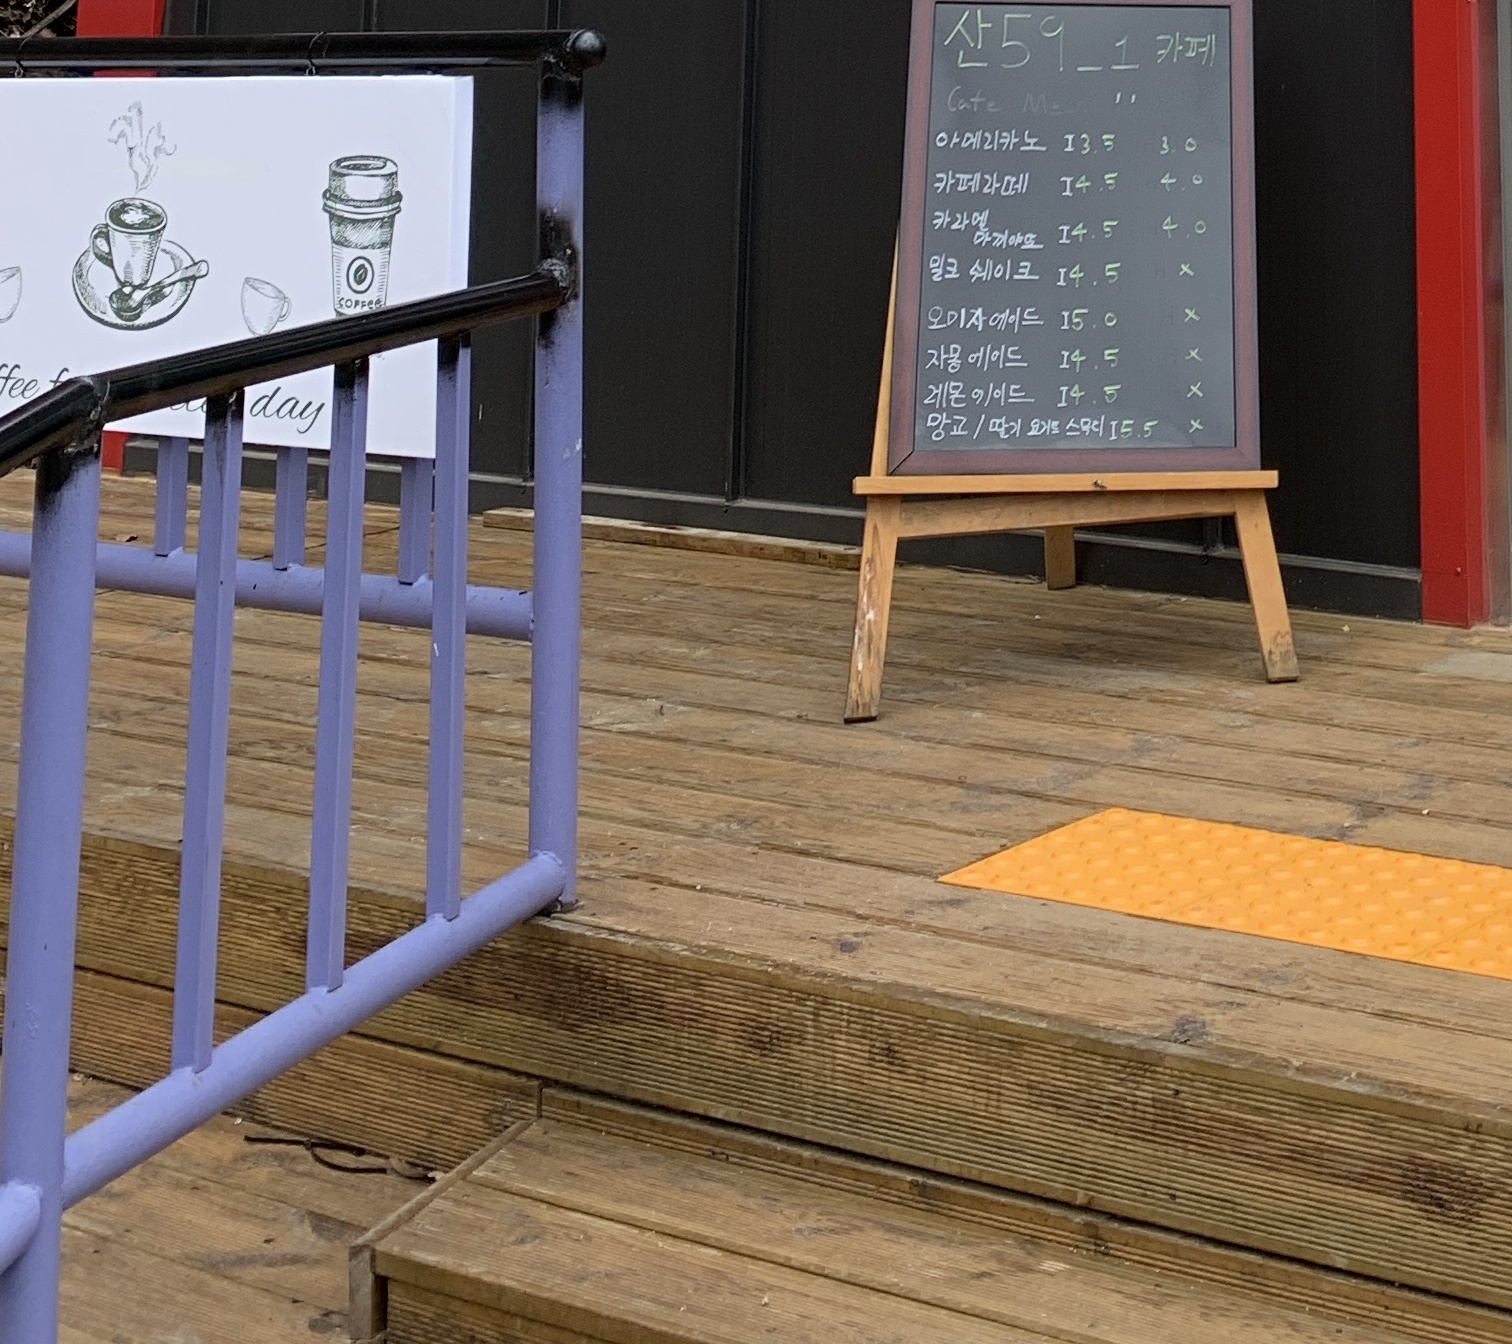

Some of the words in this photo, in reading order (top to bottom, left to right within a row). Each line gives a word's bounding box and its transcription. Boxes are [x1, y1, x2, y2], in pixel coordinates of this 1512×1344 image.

[1156, 31, 1217, 67] 카페
[935, 129, 1047, 152] 아메리카노
[934, 170, 1030, 196] 카페라떼
[249, 386, 326, 434] day
